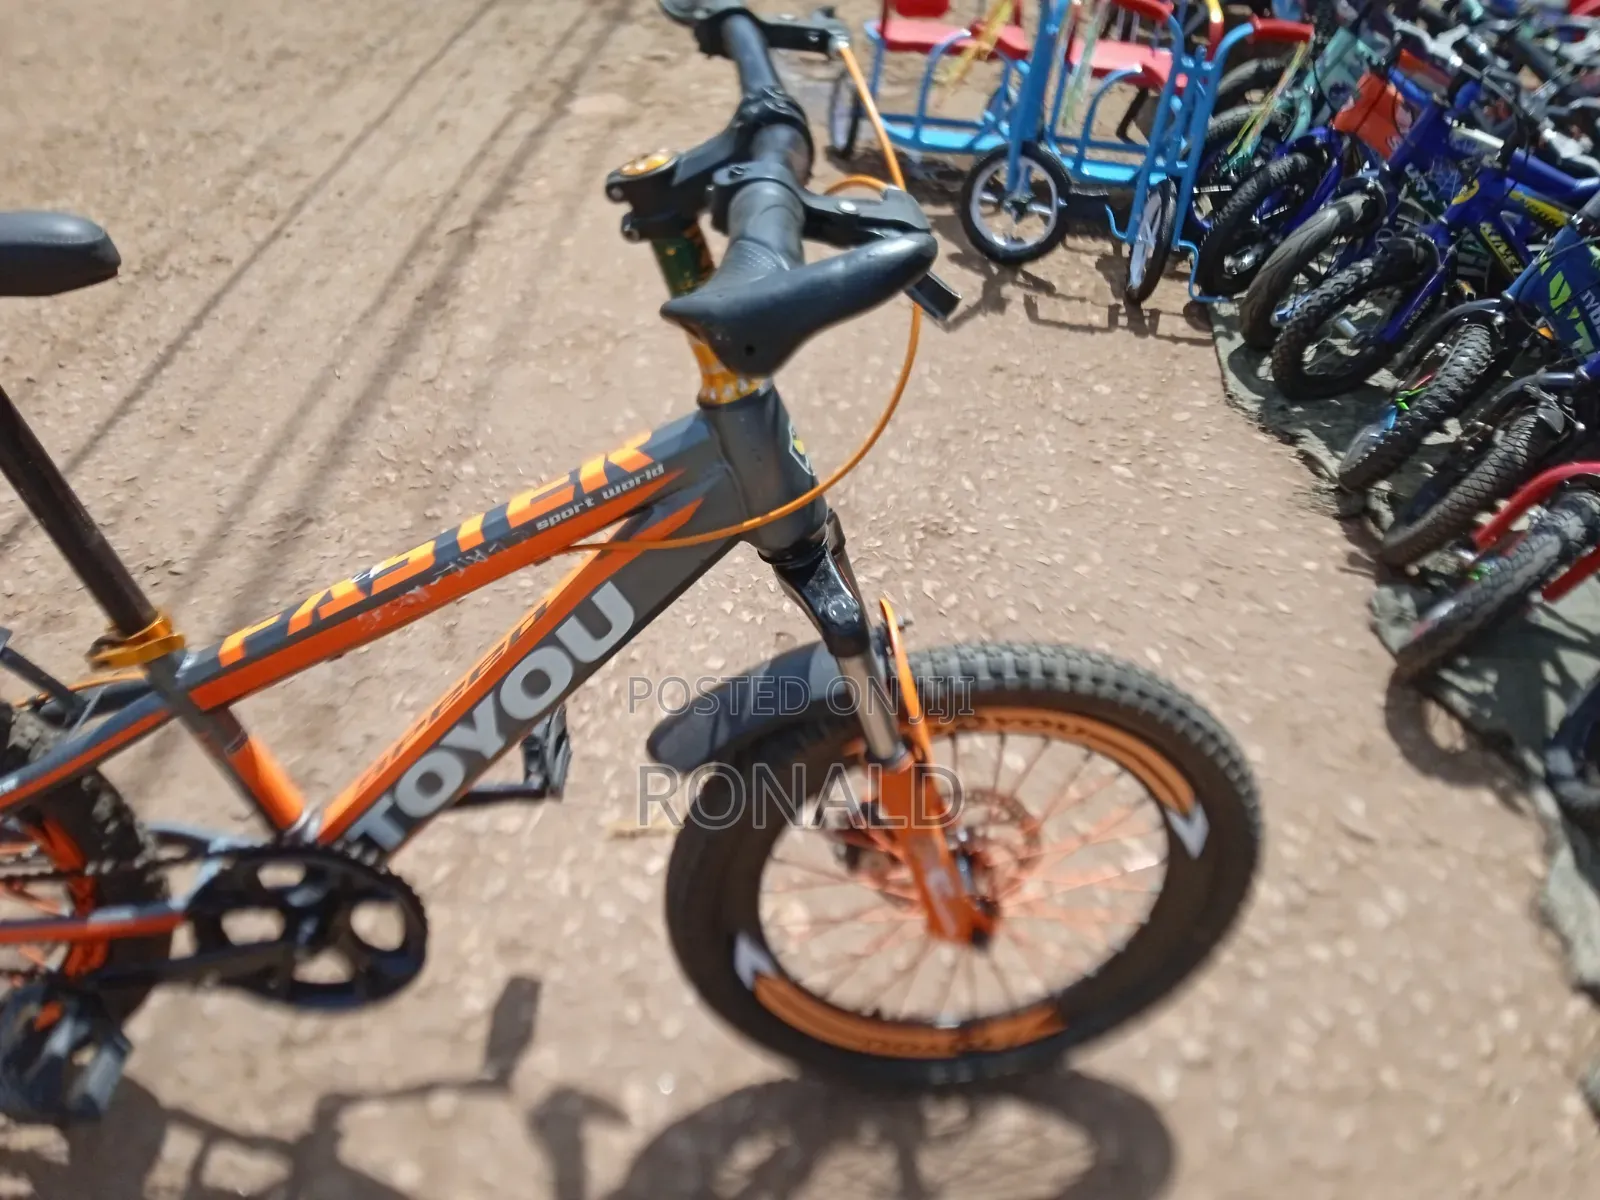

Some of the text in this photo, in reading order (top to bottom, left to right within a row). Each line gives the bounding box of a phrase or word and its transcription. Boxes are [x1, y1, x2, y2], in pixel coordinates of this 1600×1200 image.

[535, 463, 665, 531] sport world
[344, 580, 636, 850] TOYOU
